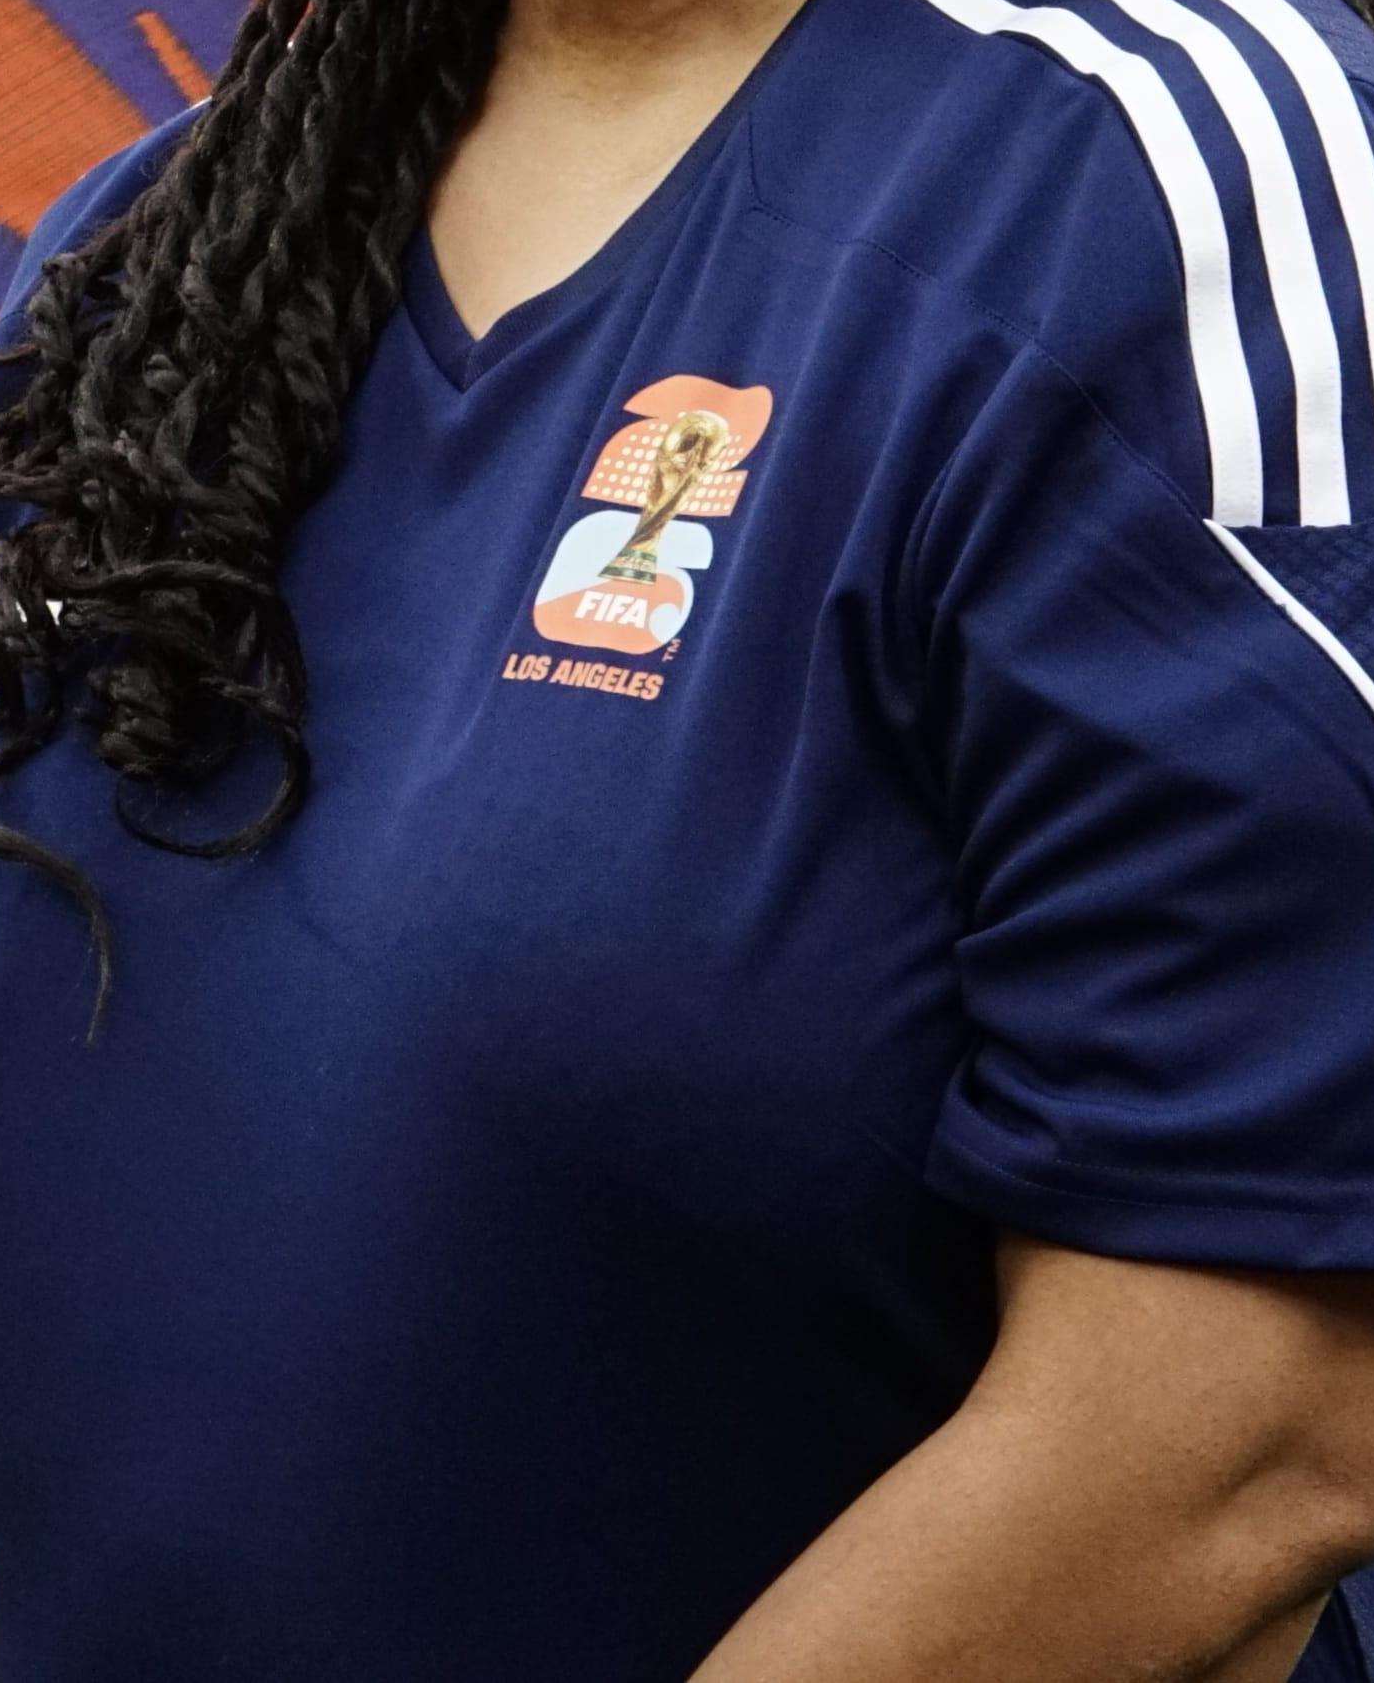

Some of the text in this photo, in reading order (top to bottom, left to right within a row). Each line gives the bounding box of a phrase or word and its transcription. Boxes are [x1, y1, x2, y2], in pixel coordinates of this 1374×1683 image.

[574, 590, 649, 630] FIFA
[502, 653, 665, 702] LOS ANGELES
